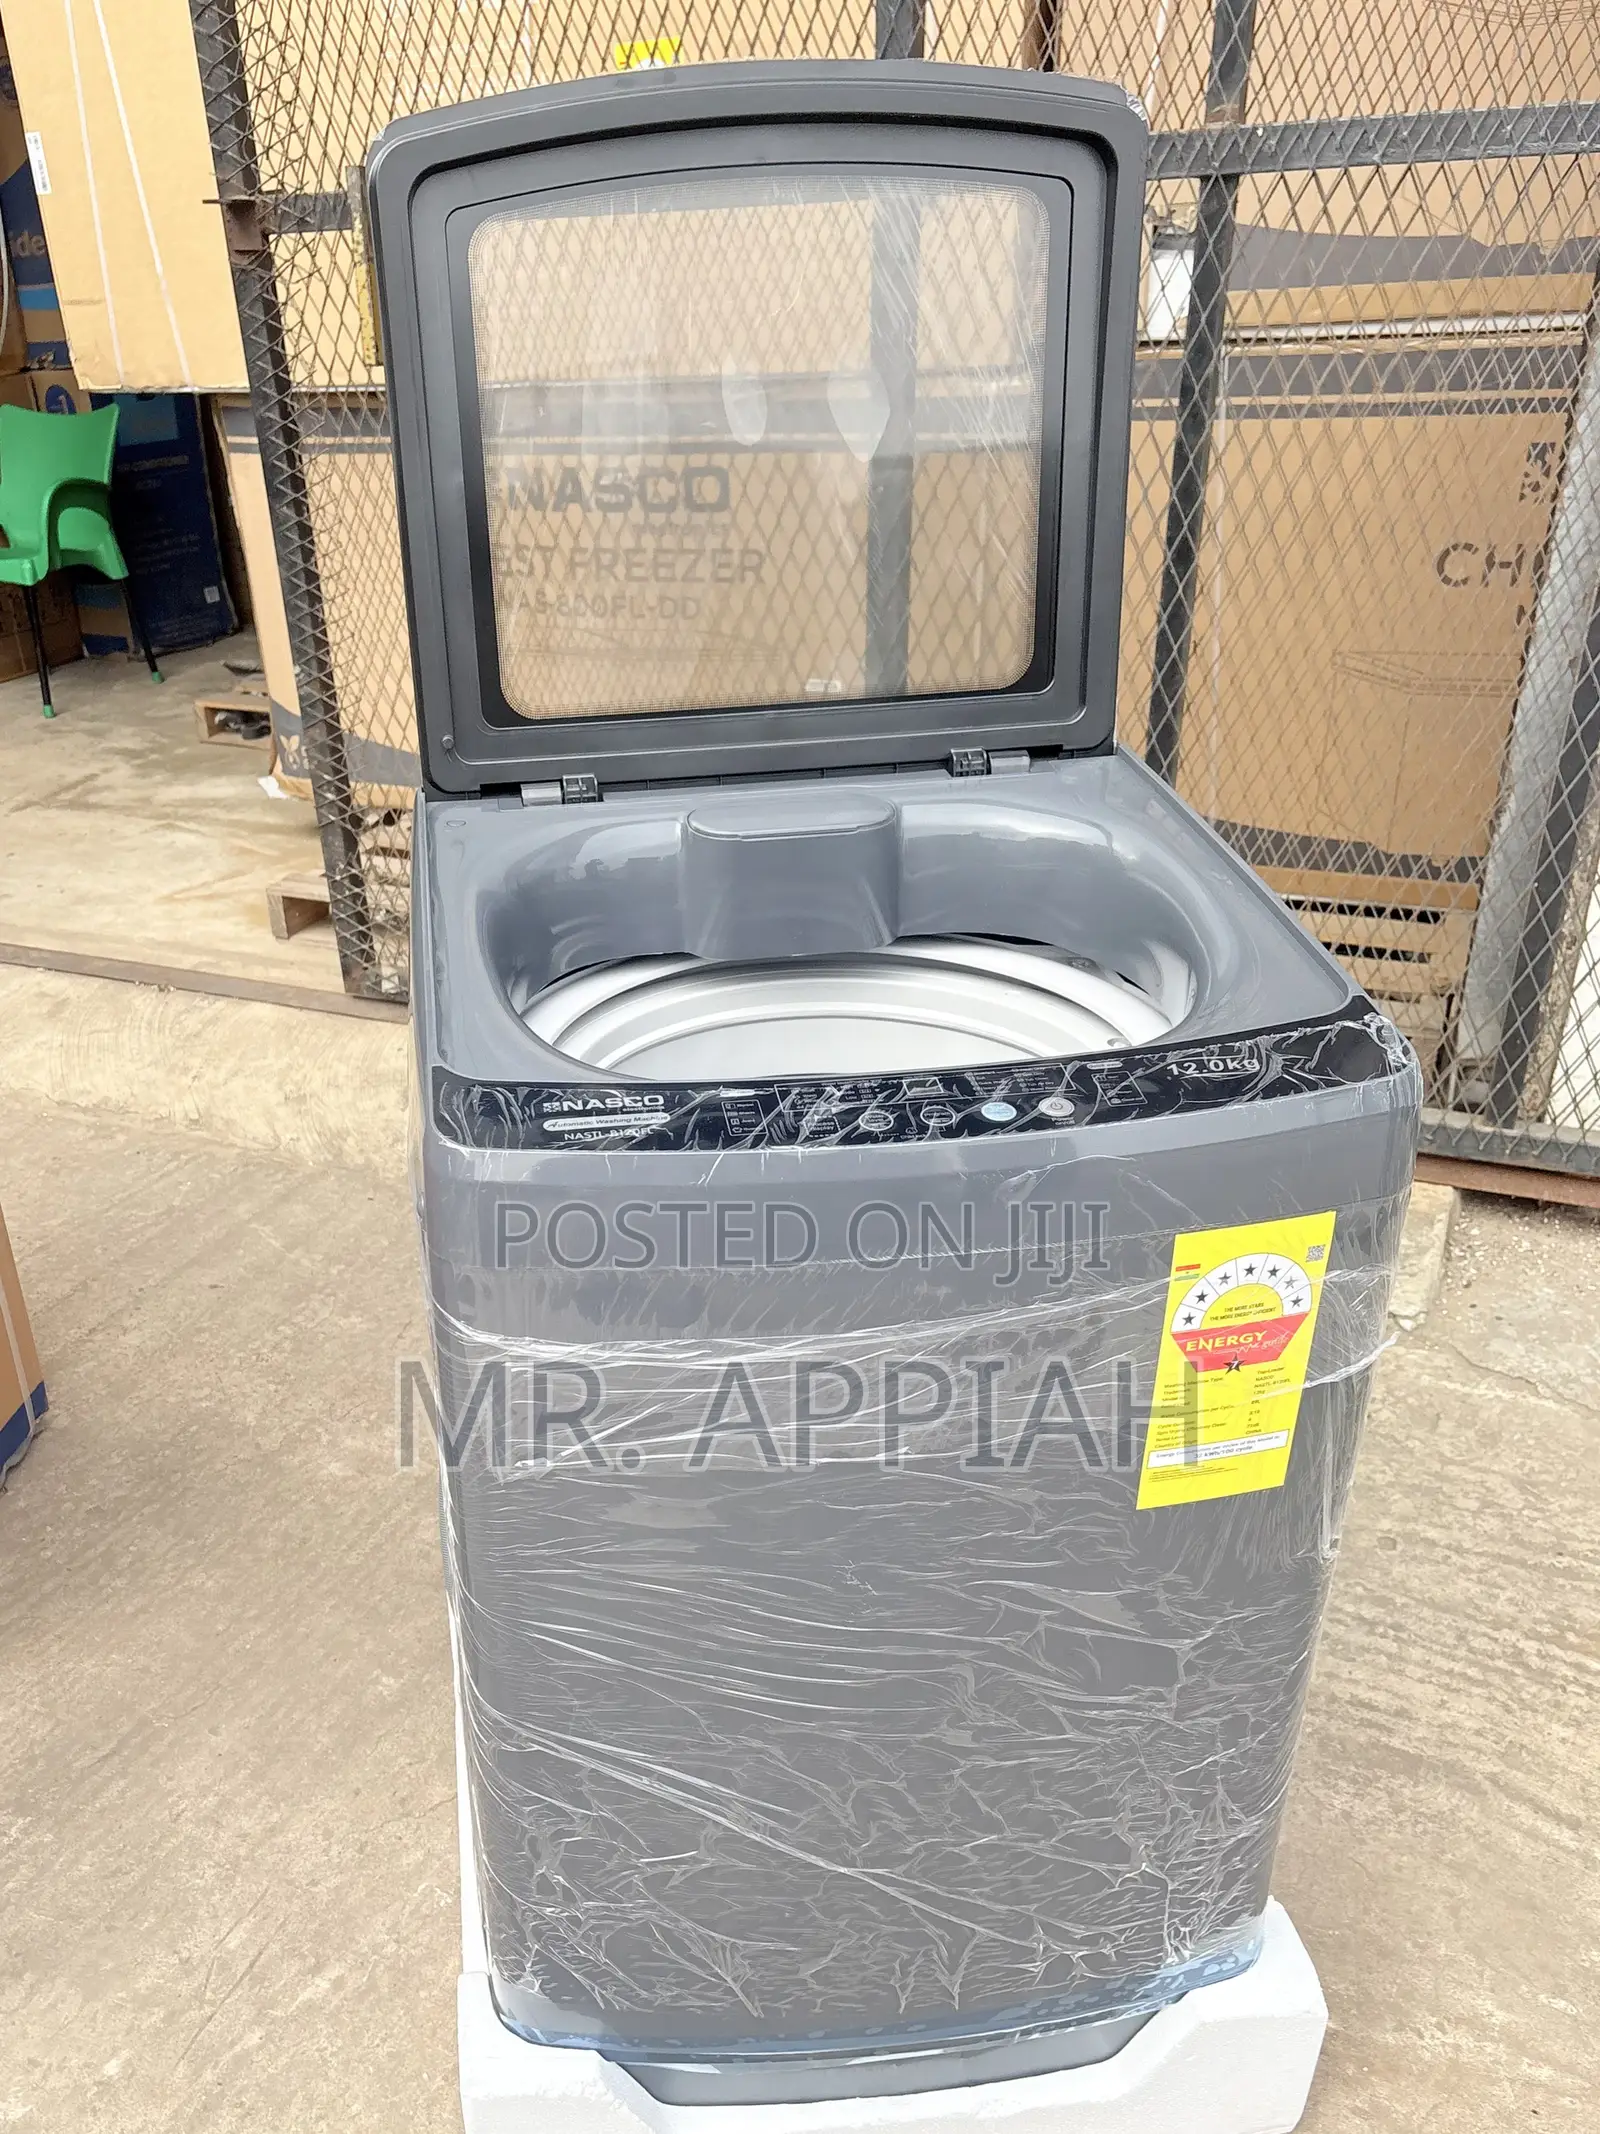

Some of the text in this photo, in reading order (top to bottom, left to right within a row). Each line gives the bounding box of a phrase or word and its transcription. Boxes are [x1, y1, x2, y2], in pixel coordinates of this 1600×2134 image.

[507, 466, 730, 512] NASCO
[570, 547, 764, 585] FREEZER
[1166, 1058, 1261, 1076] 12.0kg
[562, 1094, 665, 1112] NASCO
[595, 1117, 632, 1125] Washing
[1186, 1330, 1268, 1353] ENERGY
